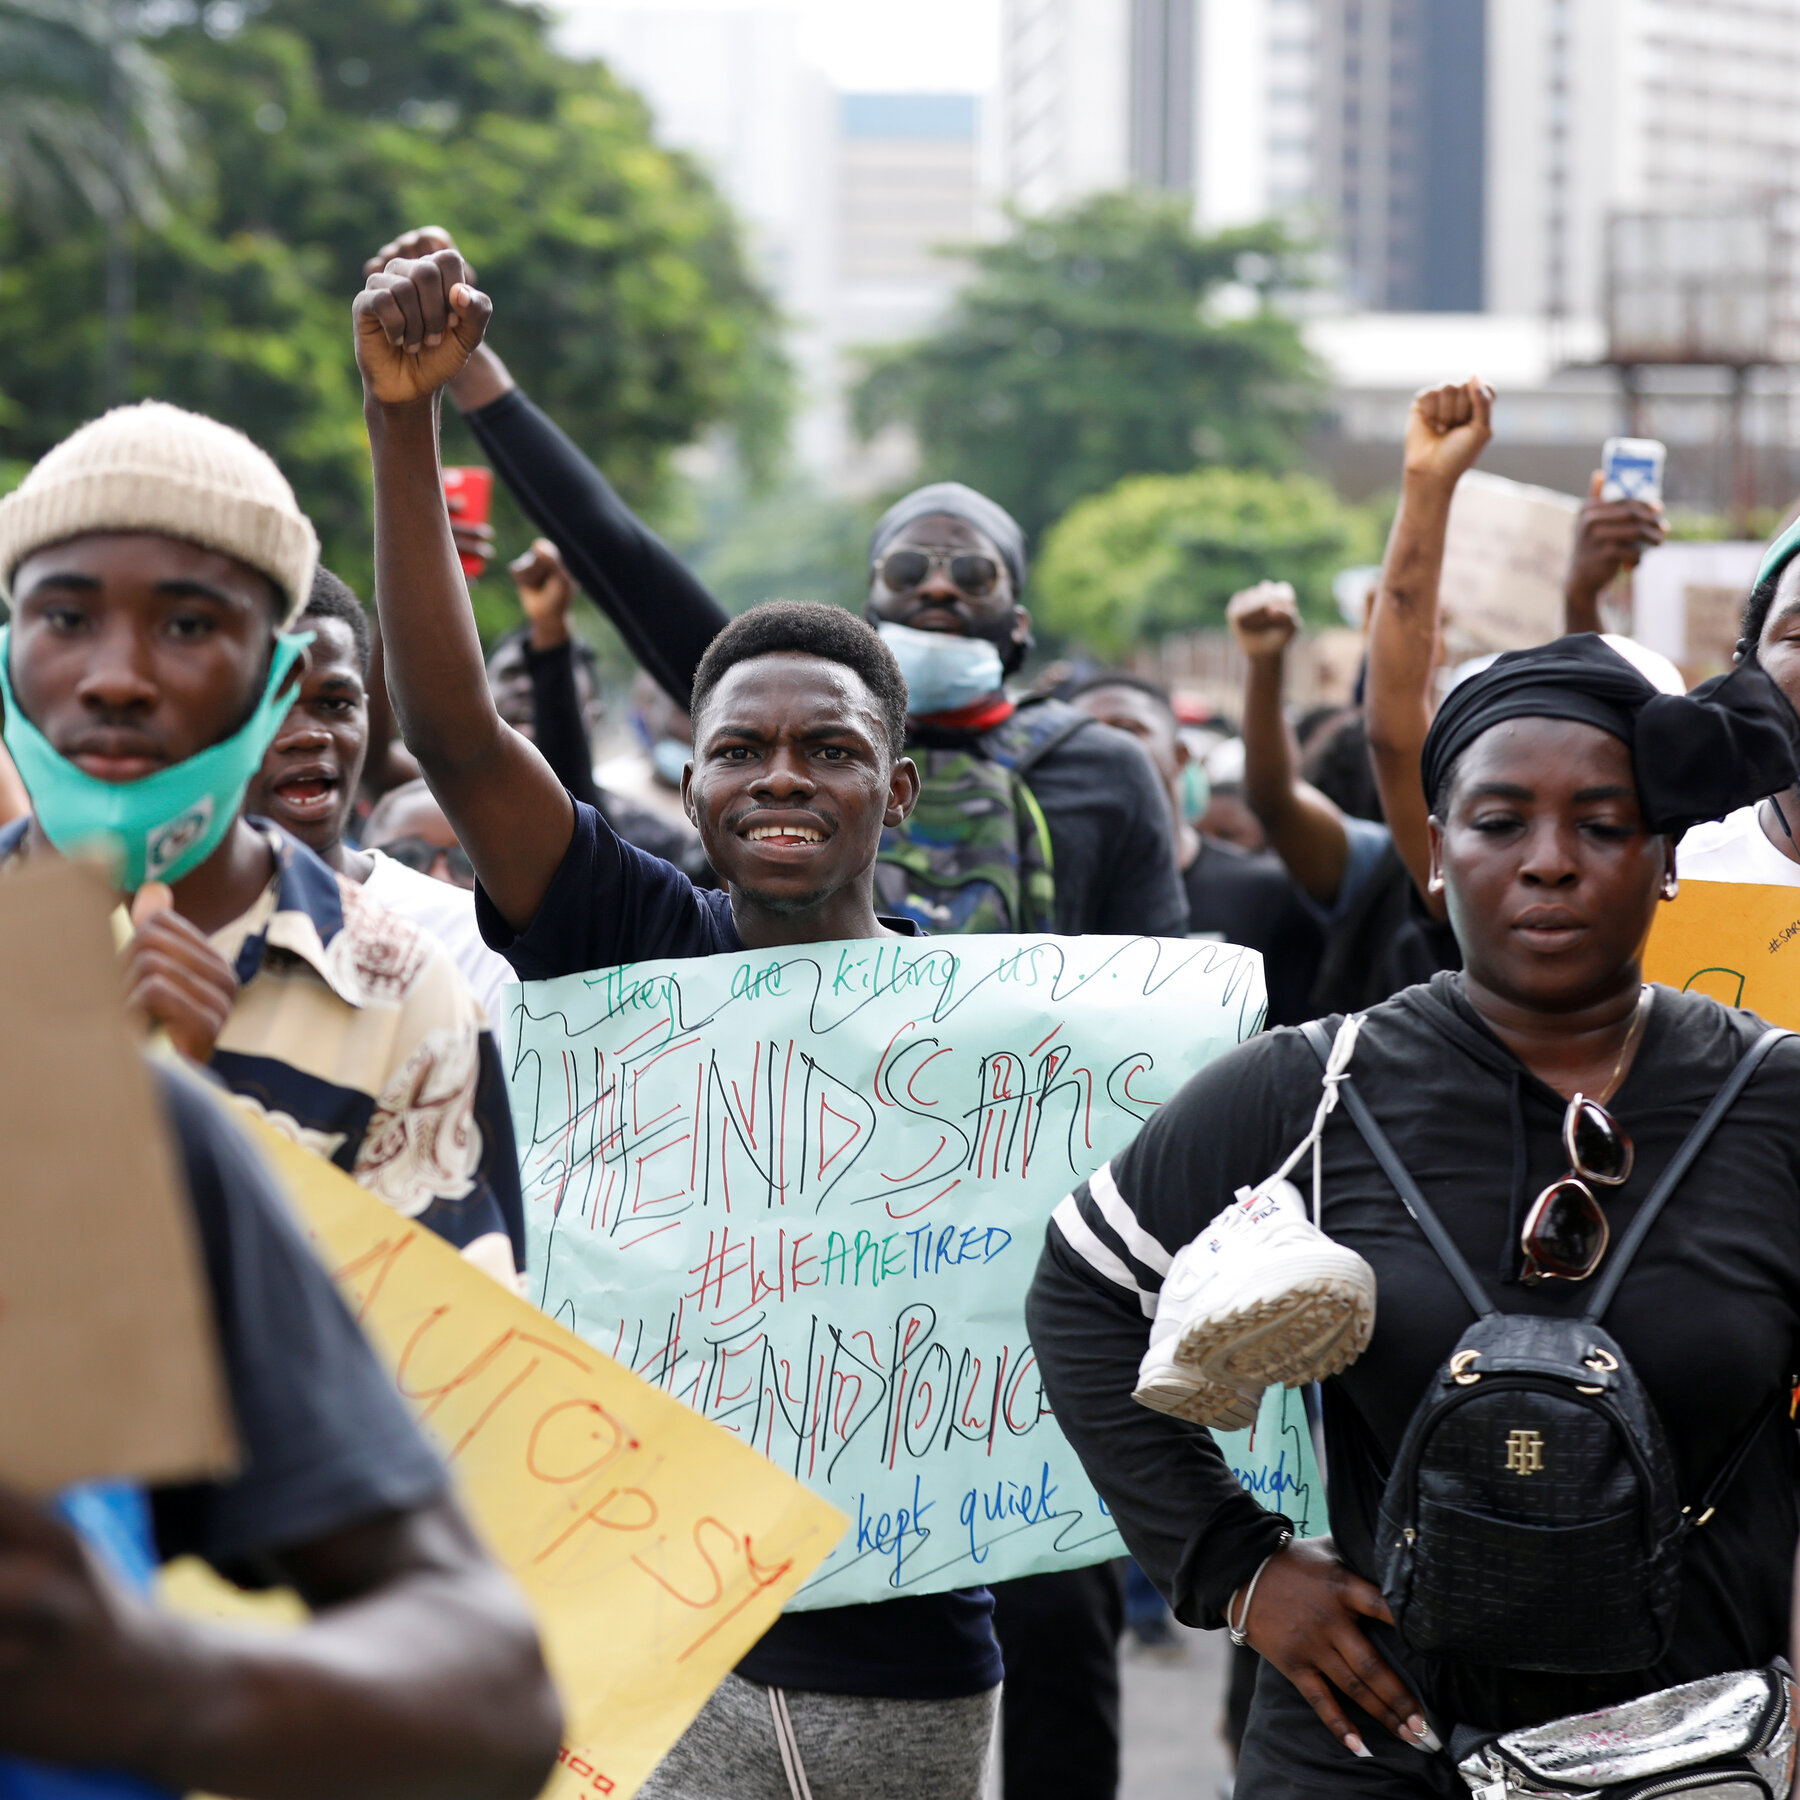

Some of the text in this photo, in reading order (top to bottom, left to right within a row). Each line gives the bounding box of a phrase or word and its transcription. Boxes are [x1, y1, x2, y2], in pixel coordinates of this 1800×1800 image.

[731, 961, 792, 1001] are
[833, 946, 962, 1022] killing
[685, 1213, 1012, 1318] #WEARETIRED
[617, 1298, 1055, 1485] #ENDPOLIC
[857, 1450, 1304, 1588] kept quiet ough
